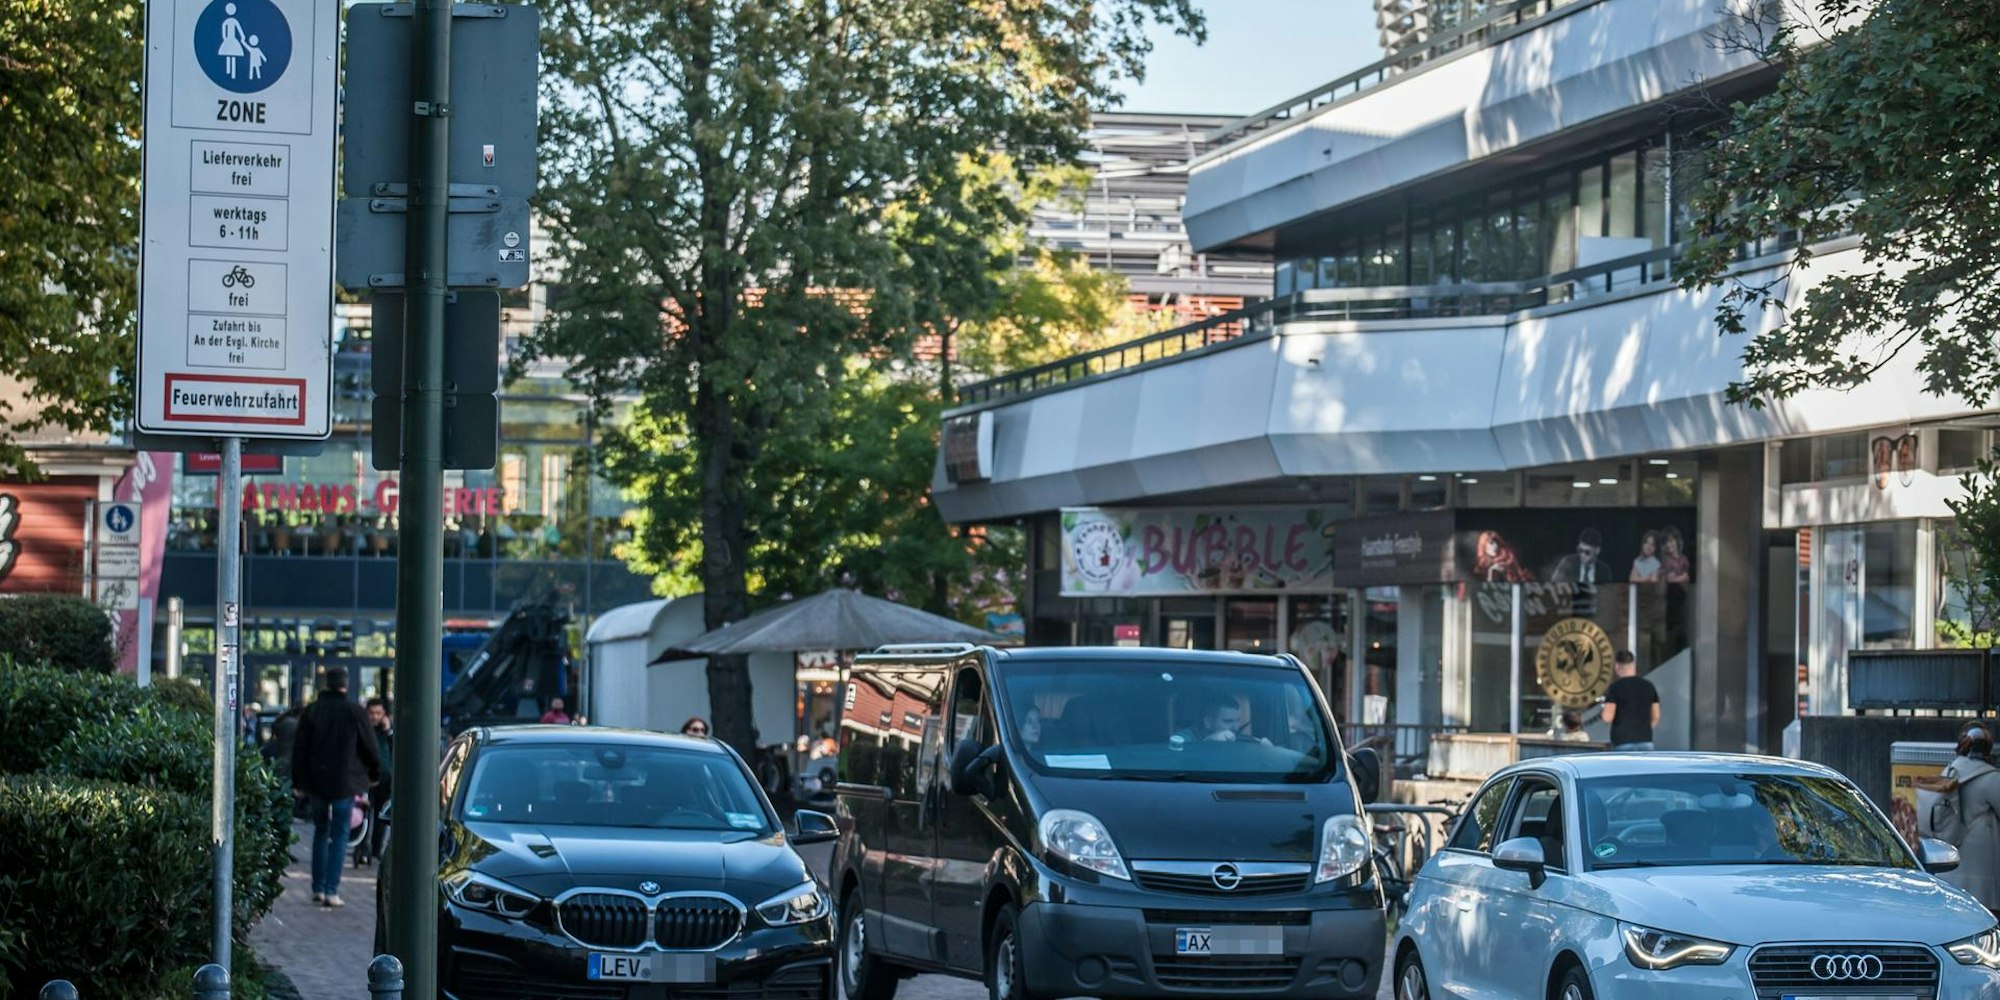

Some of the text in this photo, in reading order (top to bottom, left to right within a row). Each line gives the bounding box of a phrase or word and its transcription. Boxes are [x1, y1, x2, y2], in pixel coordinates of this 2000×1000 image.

[217, 100, 266, 123] ZONE
[203, 150, 282, 168] Lieferverkehr
[231, 171, 252, 186] frei
[213, 206, 267, 224] werktags
[219, 224, 226, 238] 6
[239, 226, 259, 240] 11h
[228, 292, 249, 307] frei
[212, 319, 262, 333] Zufahrt bis
[194, 334, 280, 350] An der Evgl. Kirche
[228, 352, 245, 364] frei
[173, 388, 298, 410] Feuerwehrzufahrt
[1141, 522, 1310, 577] BUBBLE
[1188, 934, 1211, 951] AX
[602, 957, 642, 977] LEV
